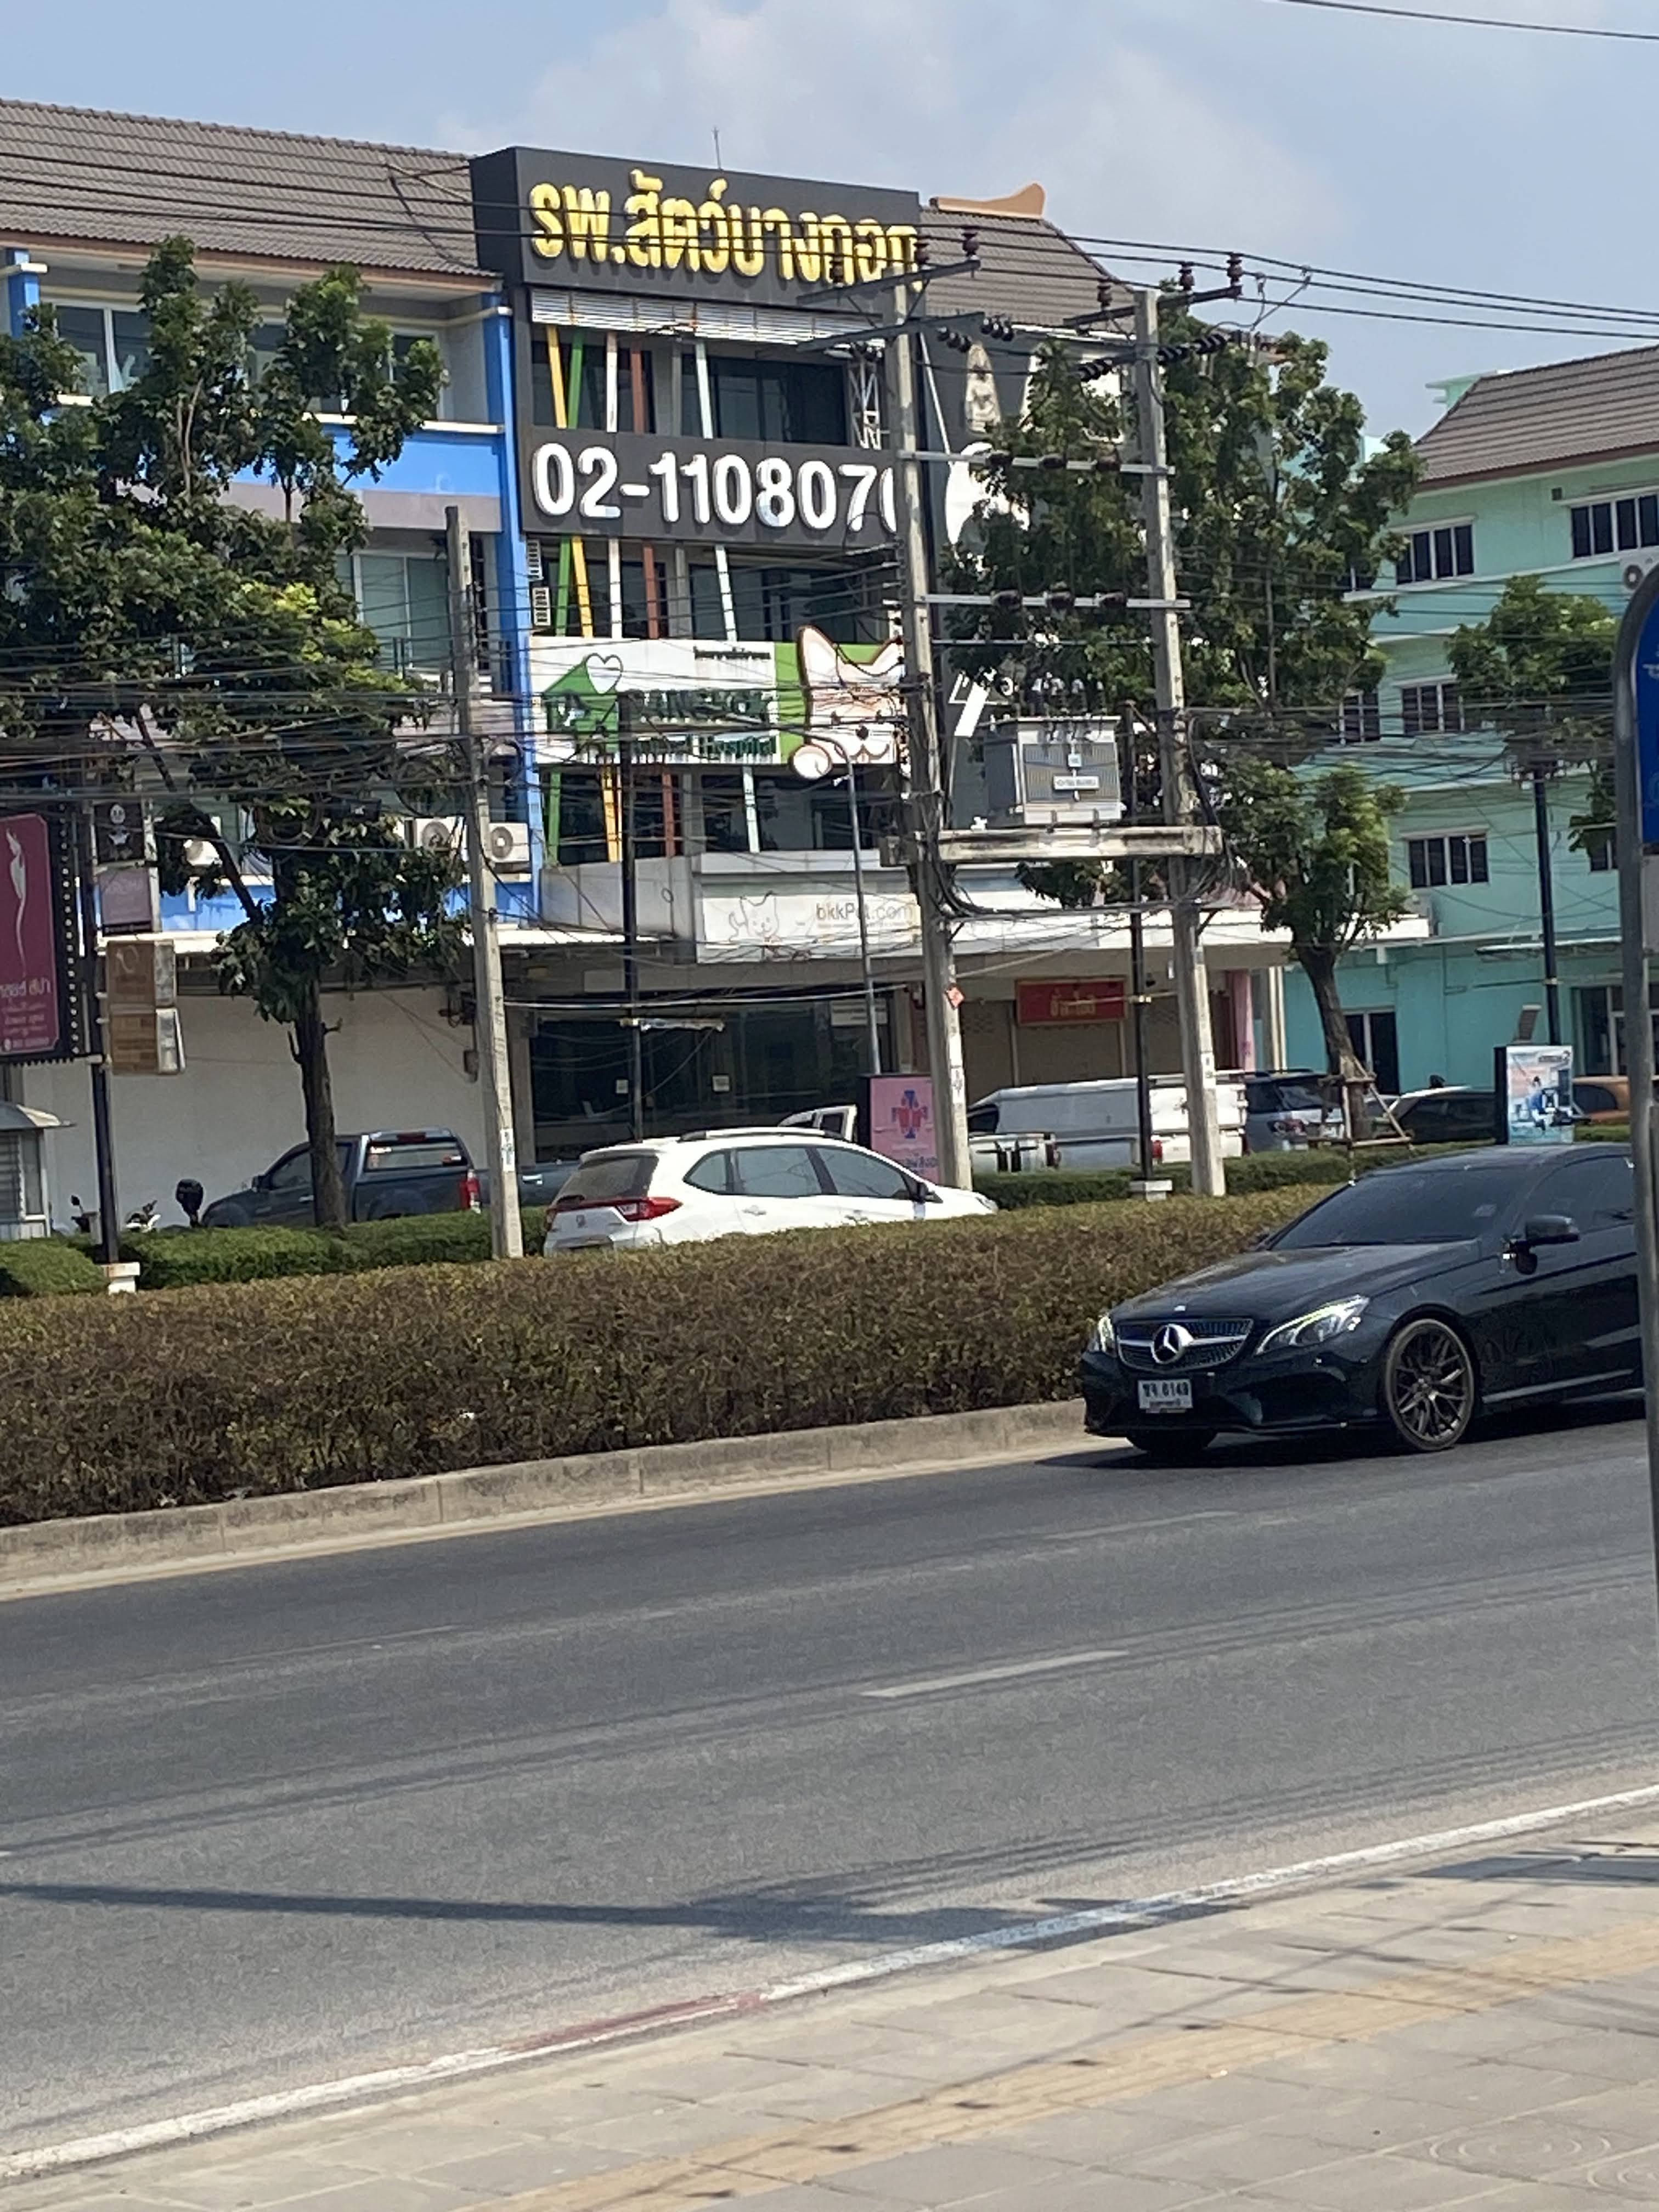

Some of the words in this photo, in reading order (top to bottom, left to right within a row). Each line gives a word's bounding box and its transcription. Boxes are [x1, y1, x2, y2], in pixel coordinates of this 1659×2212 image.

[529, 168, 923, 292] รพ.สัตว์บางกอก
[816, 902, 913, 921] bkkPt.com
